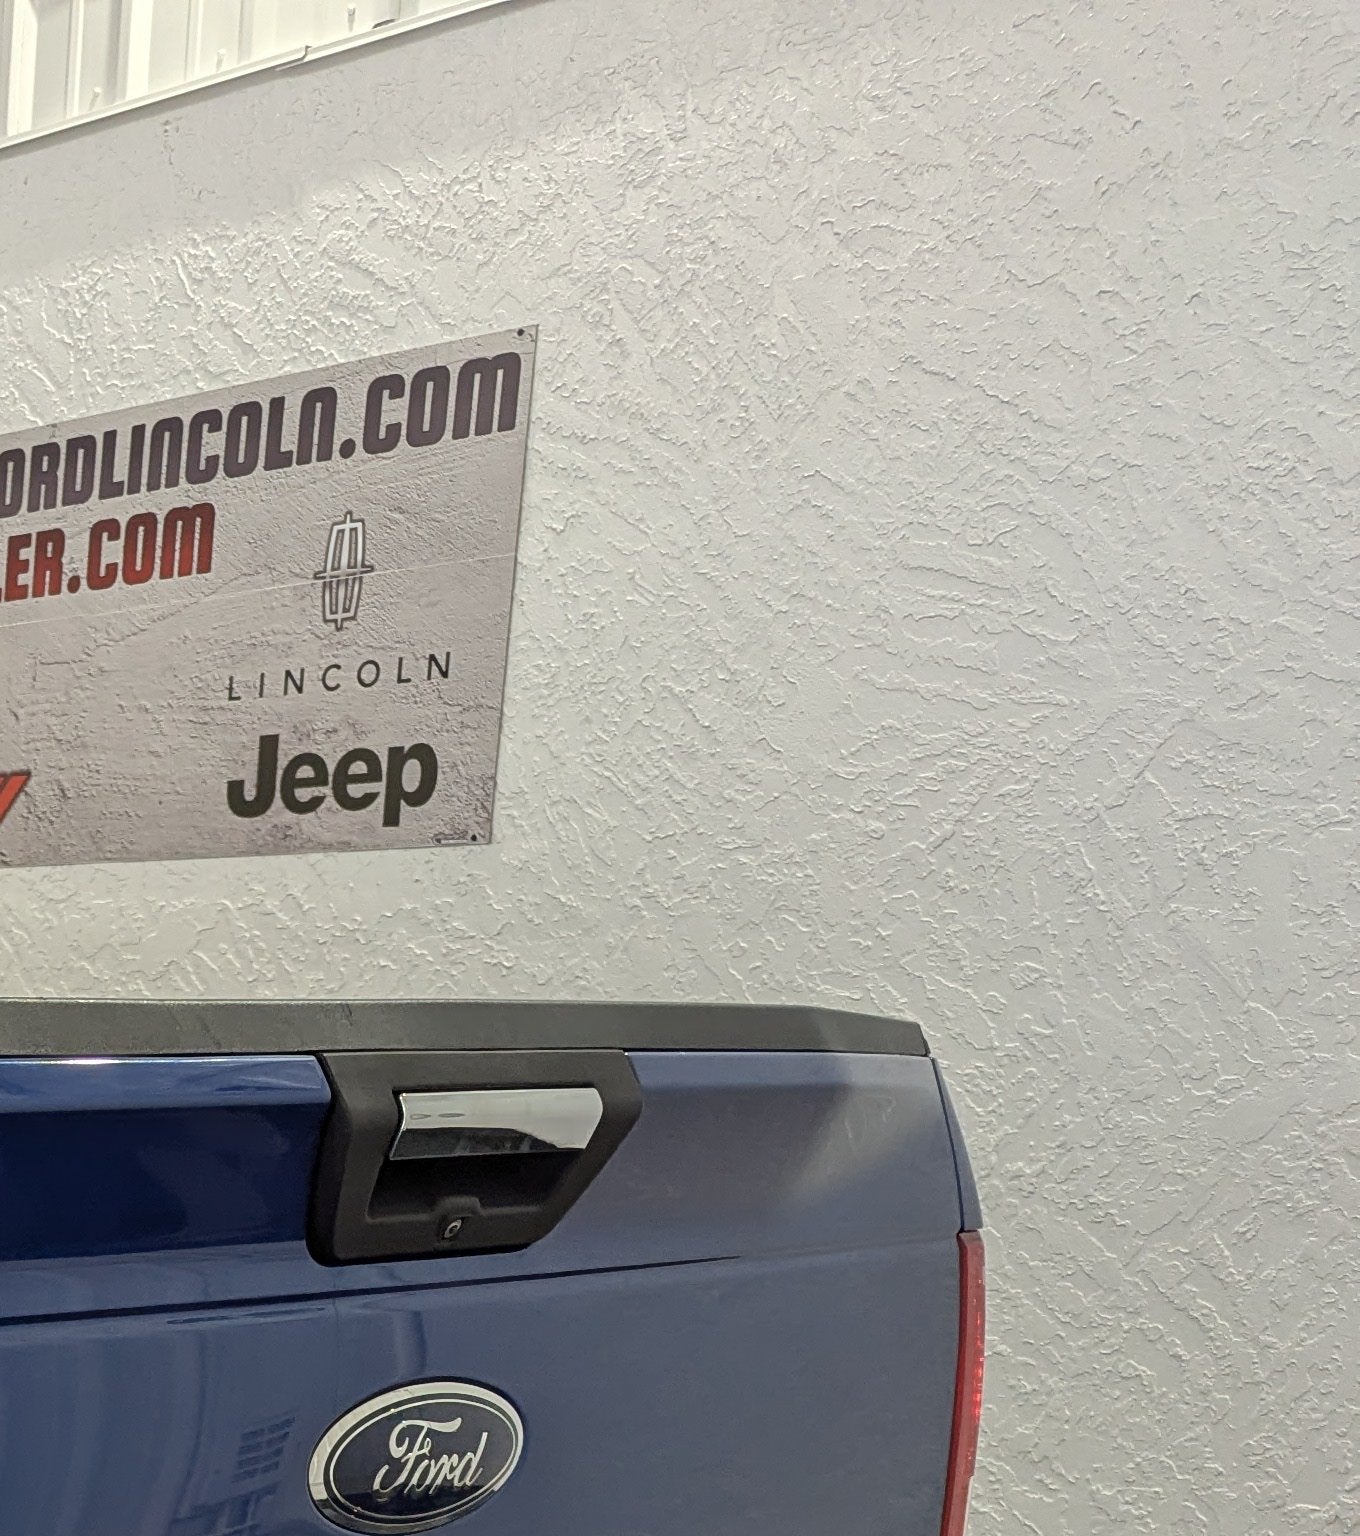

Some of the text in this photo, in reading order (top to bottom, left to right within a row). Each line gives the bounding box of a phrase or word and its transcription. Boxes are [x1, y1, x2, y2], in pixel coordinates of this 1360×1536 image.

[228, 651, 451, 702] LINCOLN
[226, 733, 439, 828] Jeep
[370, 1415, 489, 1500] Ford
